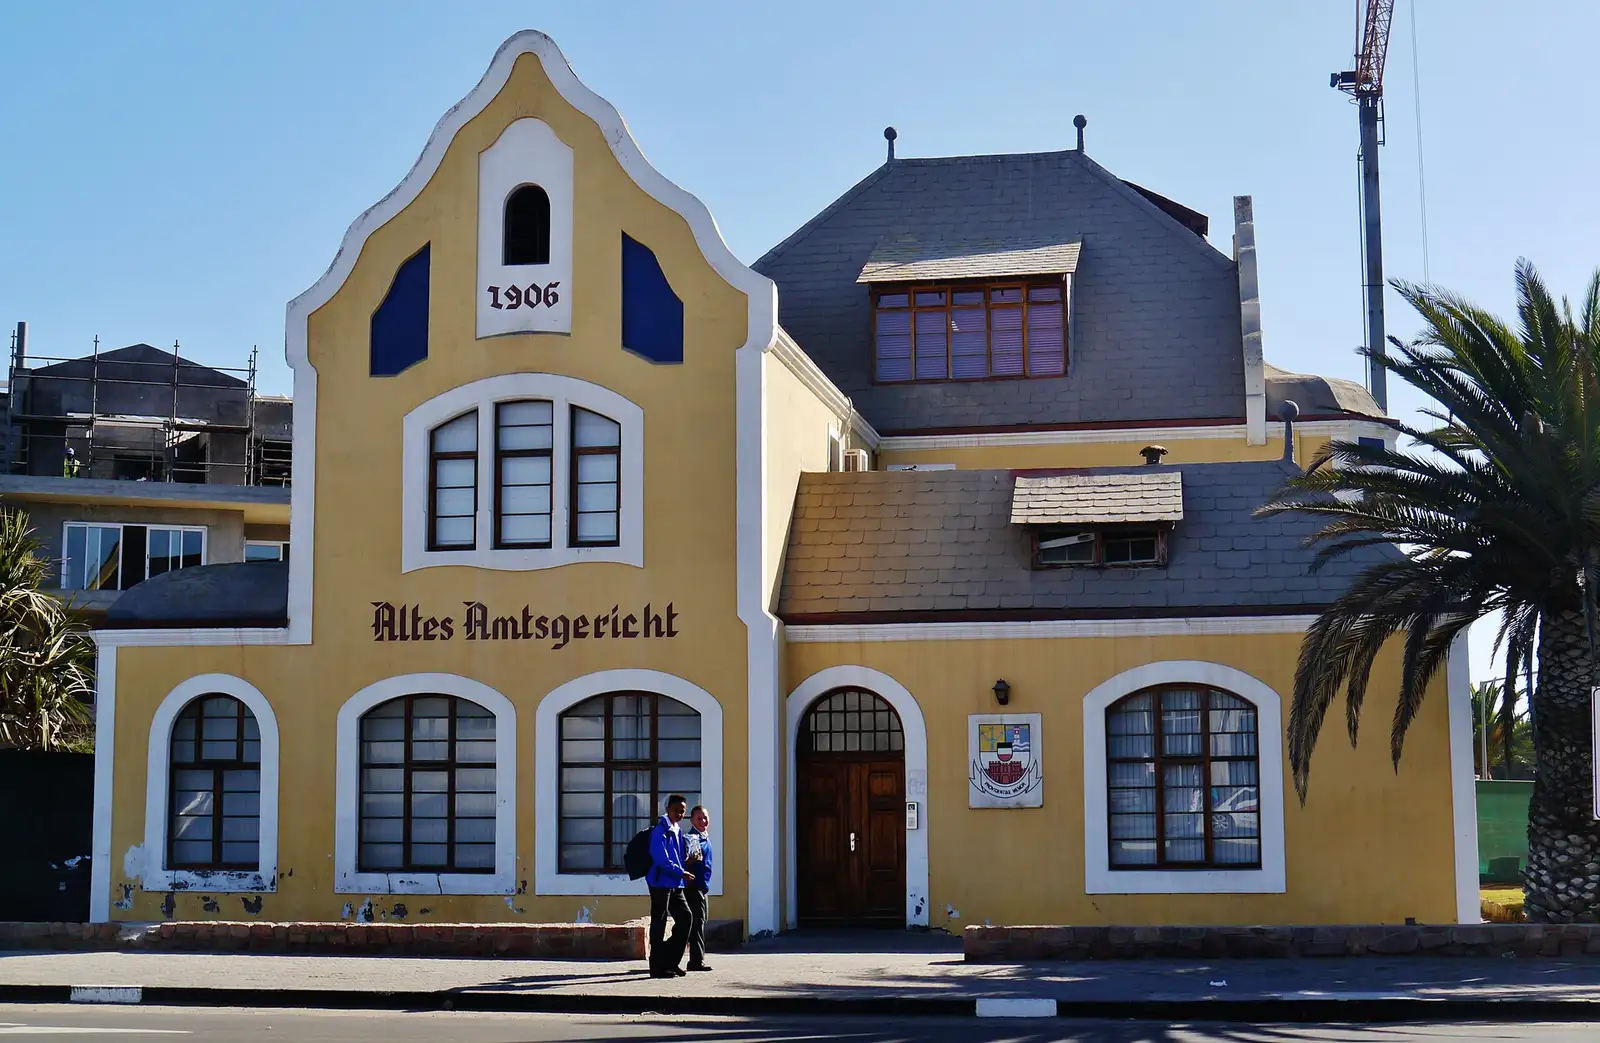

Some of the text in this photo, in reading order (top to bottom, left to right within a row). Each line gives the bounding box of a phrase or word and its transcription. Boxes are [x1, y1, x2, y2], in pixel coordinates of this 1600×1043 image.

[487, 281, 561, 310] 1906
[370, 601, 680, 650] Altes Amtsgericht
